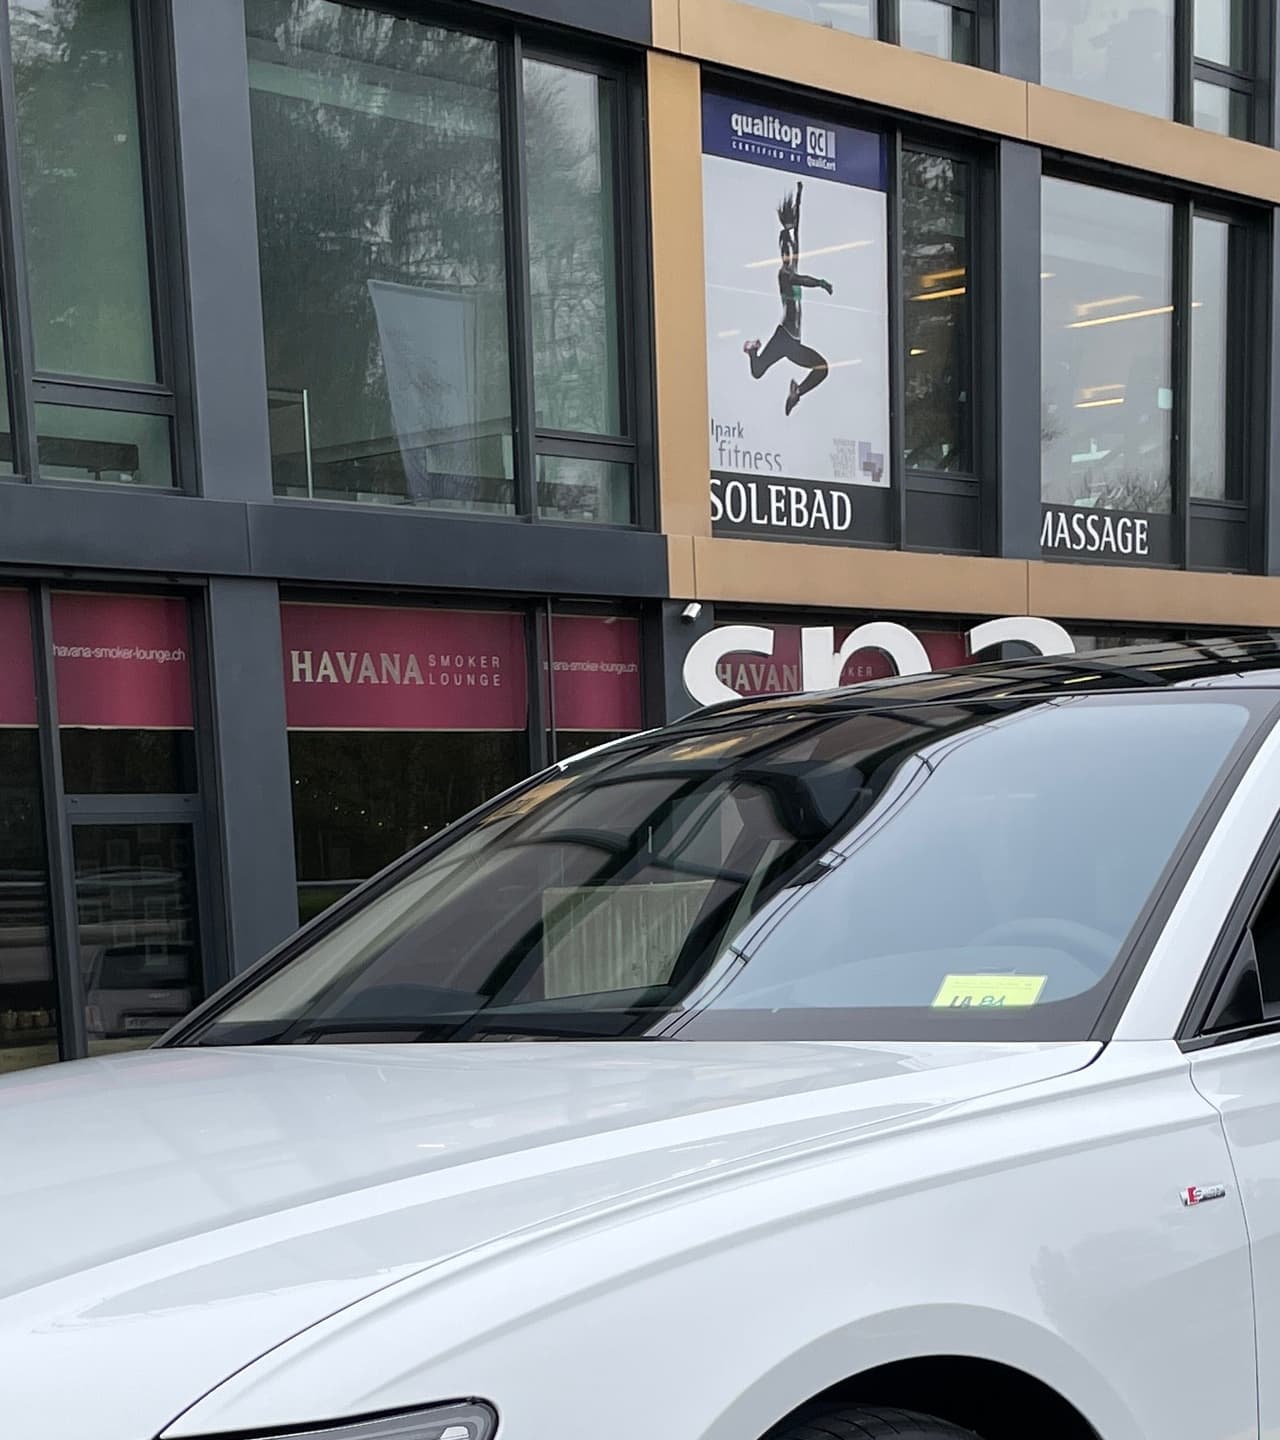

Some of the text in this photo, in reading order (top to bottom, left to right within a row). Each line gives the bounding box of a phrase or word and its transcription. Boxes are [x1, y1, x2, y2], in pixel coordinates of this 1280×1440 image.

[730, 113, 803, 149] qualitop
[717, 440, 783, 472] fitness
[709, 478, 853, 531] SOLEBAD
[290, 650, 425, 685] HAVANA
[428, 654, 501, 669] SMOKER
[428, 672, 501, 687] LOUNGE
